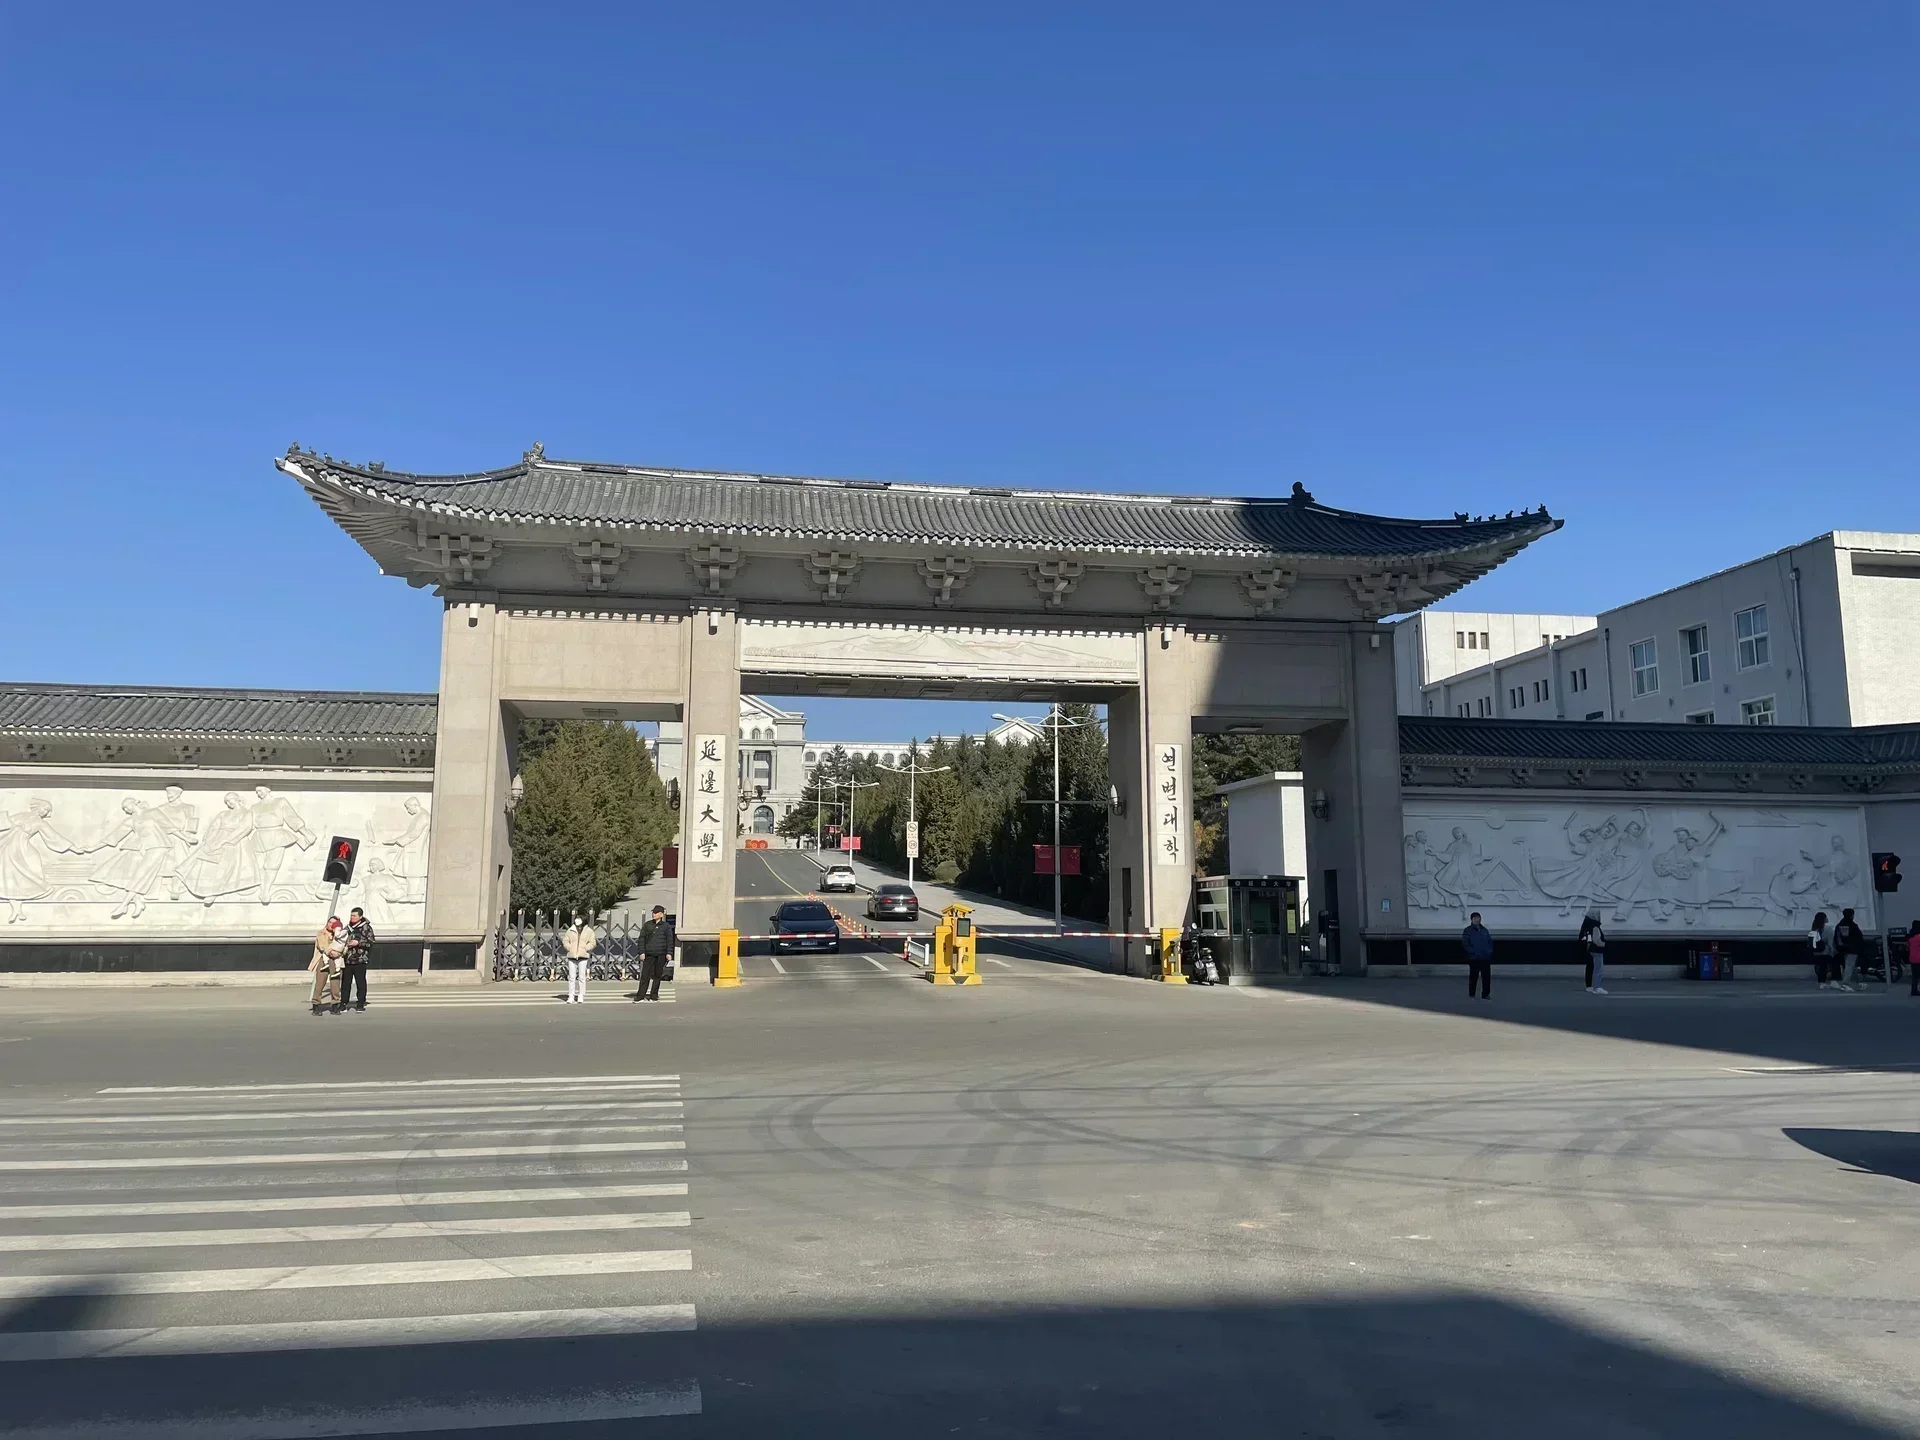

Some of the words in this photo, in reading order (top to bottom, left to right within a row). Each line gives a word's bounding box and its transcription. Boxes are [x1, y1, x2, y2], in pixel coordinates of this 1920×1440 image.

[698, 739, 722, 857] 延邊大學
[1161, 746, 1179, 864] 연변대학
